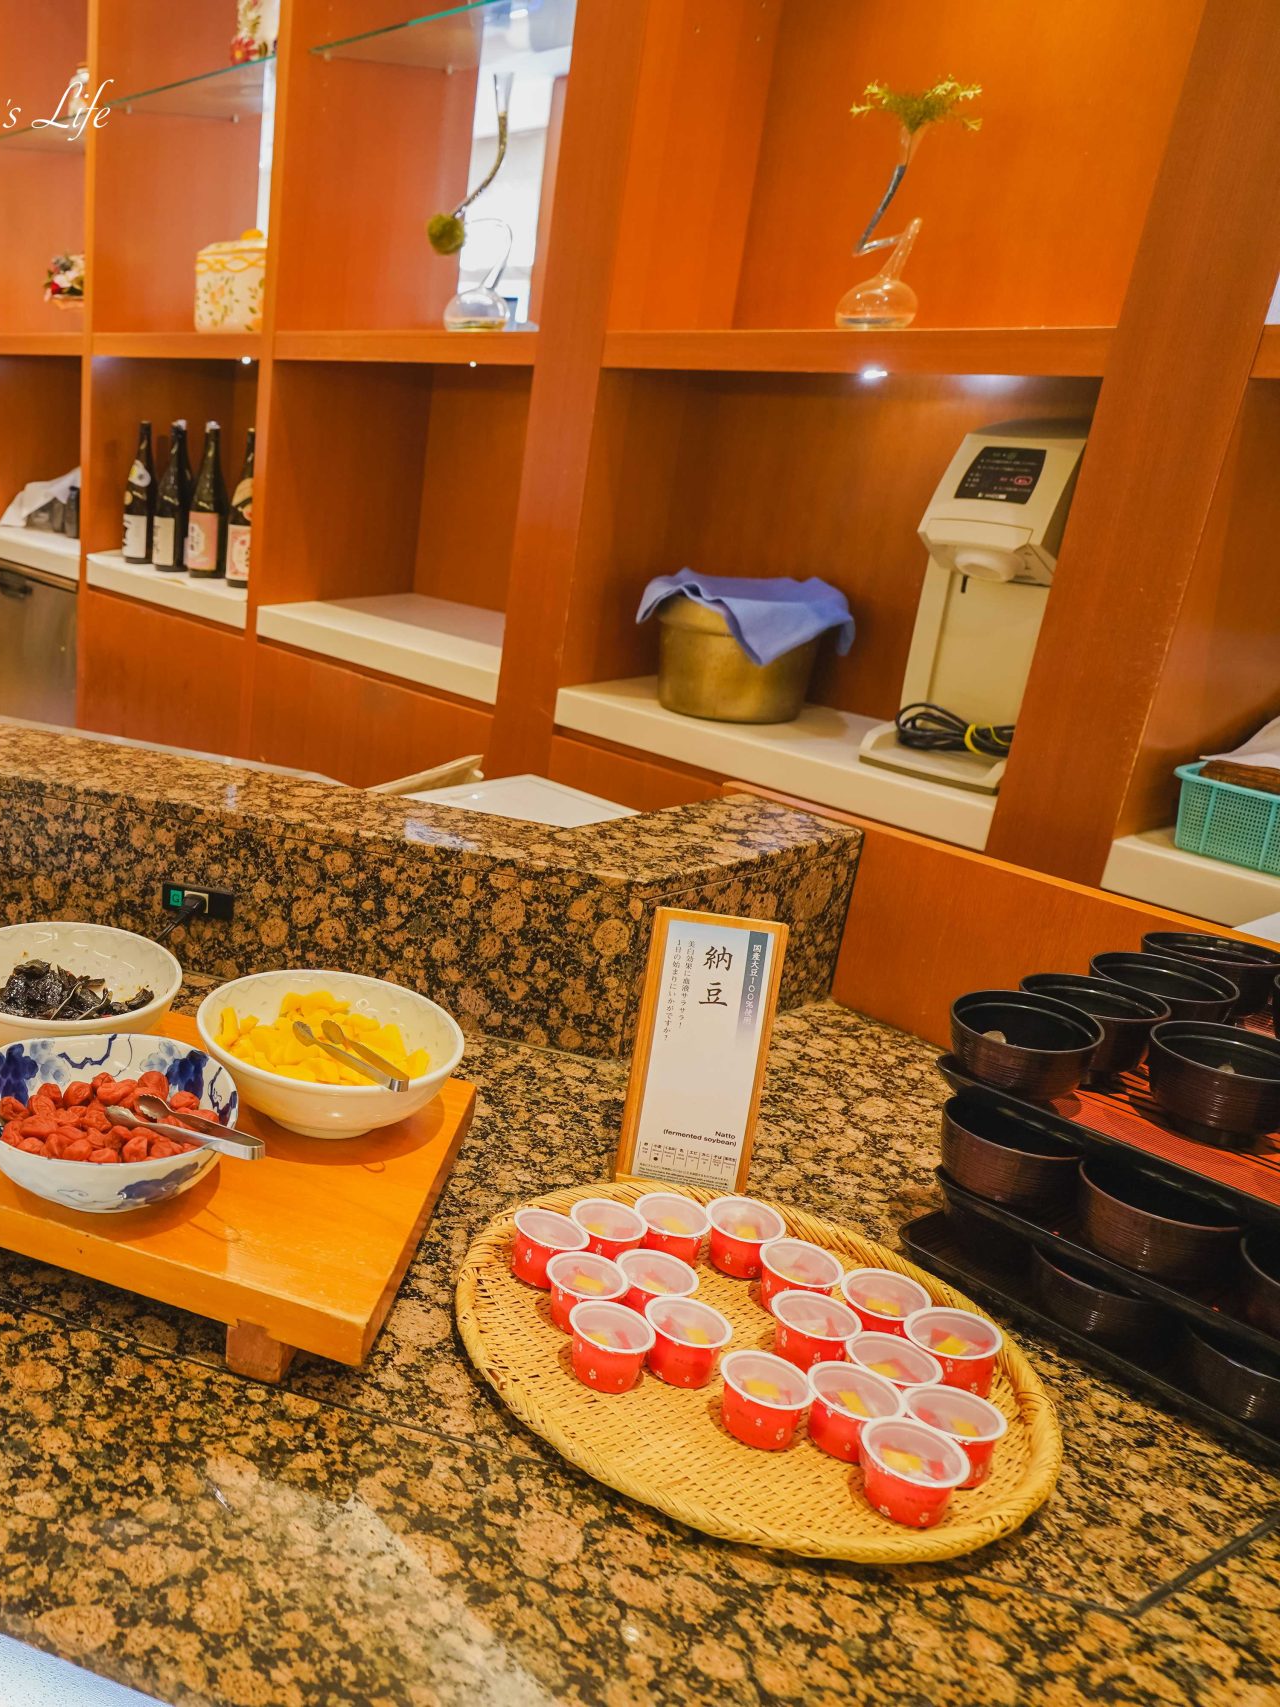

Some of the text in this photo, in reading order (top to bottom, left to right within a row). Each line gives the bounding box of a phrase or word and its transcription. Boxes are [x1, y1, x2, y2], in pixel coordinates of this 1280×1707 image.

[698, 945, 734, 1007] 納豆
[663, 1128, 737, 1147] (fermented soybean)
[714, 1130, 736, 1140] Natto
